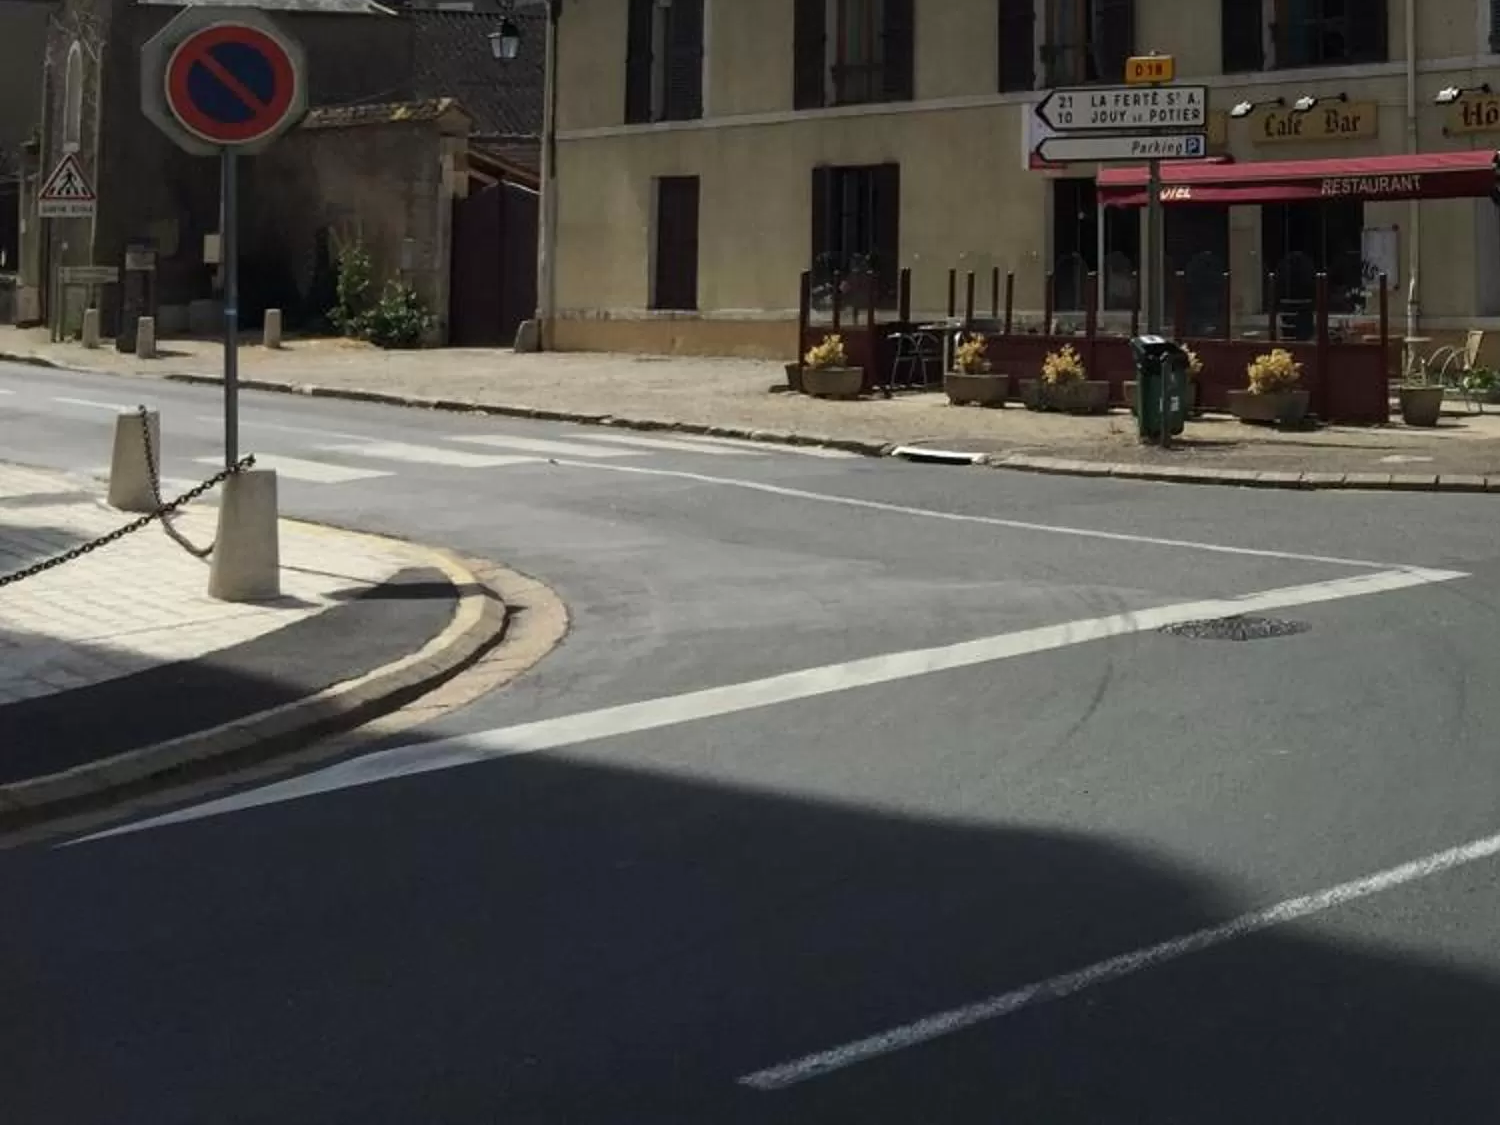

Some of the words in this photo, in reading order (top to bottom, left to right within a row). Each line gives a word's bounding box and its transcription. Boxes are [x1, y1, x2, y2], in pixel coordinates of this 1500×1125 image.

[1058, 96, 1073, 109] 21
[1091, 95, 1106, 108] LA
[1114, 92, 1159, 108] FERTÉ
[1058, 112, 1073, 124] 10
[1091, 110, 1127, 124] JOUY
[1149, 108, 1201, 123] POTIER
[1324, 109, 1361, 134] Bar
[1131, 139, 1183, 156] Parking
[1321, 174, 1421, 195] RESTAURANT
